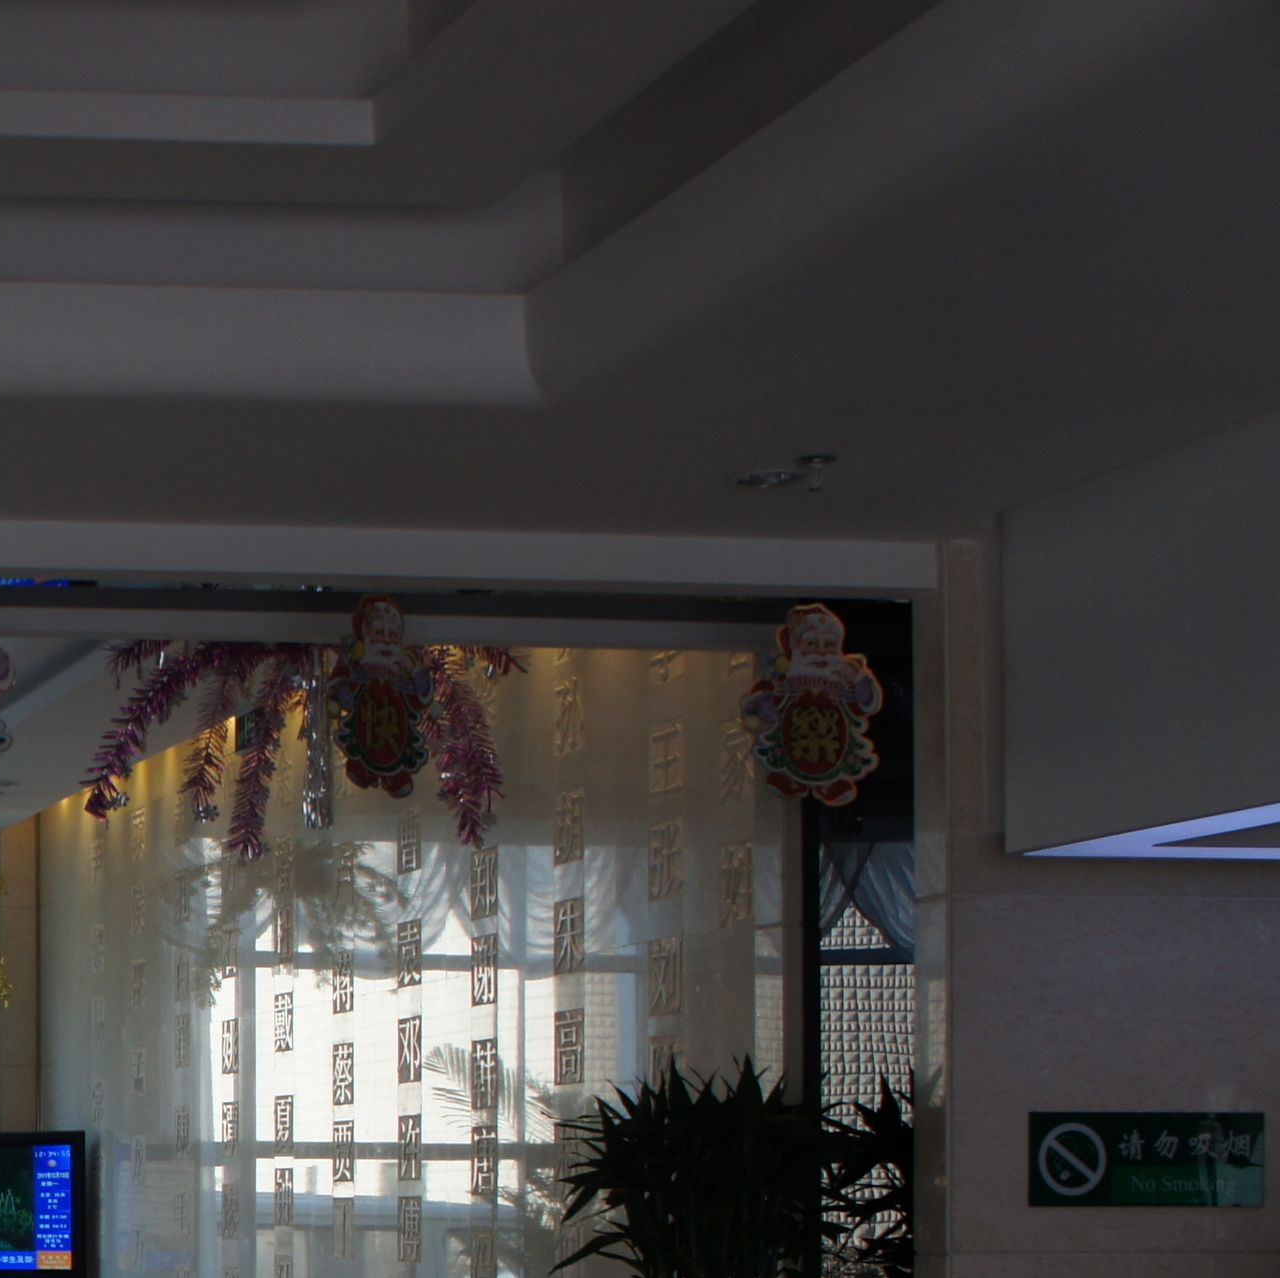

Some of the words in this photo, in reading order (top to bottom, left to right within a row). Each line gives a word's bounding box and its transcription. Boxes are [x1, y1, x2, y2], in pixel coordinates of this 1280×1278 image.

[362, 693, 402, 753] 快
[790, 705, 839, 764] 樂
[649, 719, 683, 796] 王
[720, 718, 754, 799] 家
[397, 809, 422, 873] 曹
[553, 788, 584, 866] 胡
[649, 818, 683, 901] 张
[471, 847, 498, 920] 郑
[720, 843, 753, 928] 姓
[397, 920, 422, 987] 袁
[553, 898, 584, 975] 朱
[332, 951, 354, 1013] 蒋
[471, 935, 498, 1007] 谢
[649, 937, 683, 1015] 刘
[222, 1019, 239, 1073] 姚
[274, 991, 293, 1051] 戴
[397, 1018, 422, 1083] 邓
[554, 1010, 584, 1085] 高
[332, 1043, 354, 1105] 蔡
[471, 1040, 498, 1108] 韩
[274, 1094, 293, 1153] 夏
[332, 1121, 354, 1181] 贾
[397, 1117, 422, 1180] 许
[1117, 1128, 1252, 1160] 请勿吸烟
[471, 1127, 498, 1194] 唐
[1130, 1174, 1156, 1192] No
[1160, 1174, 1236, 1196] Smoking
[397, 1198, 422, 1262] 傅
